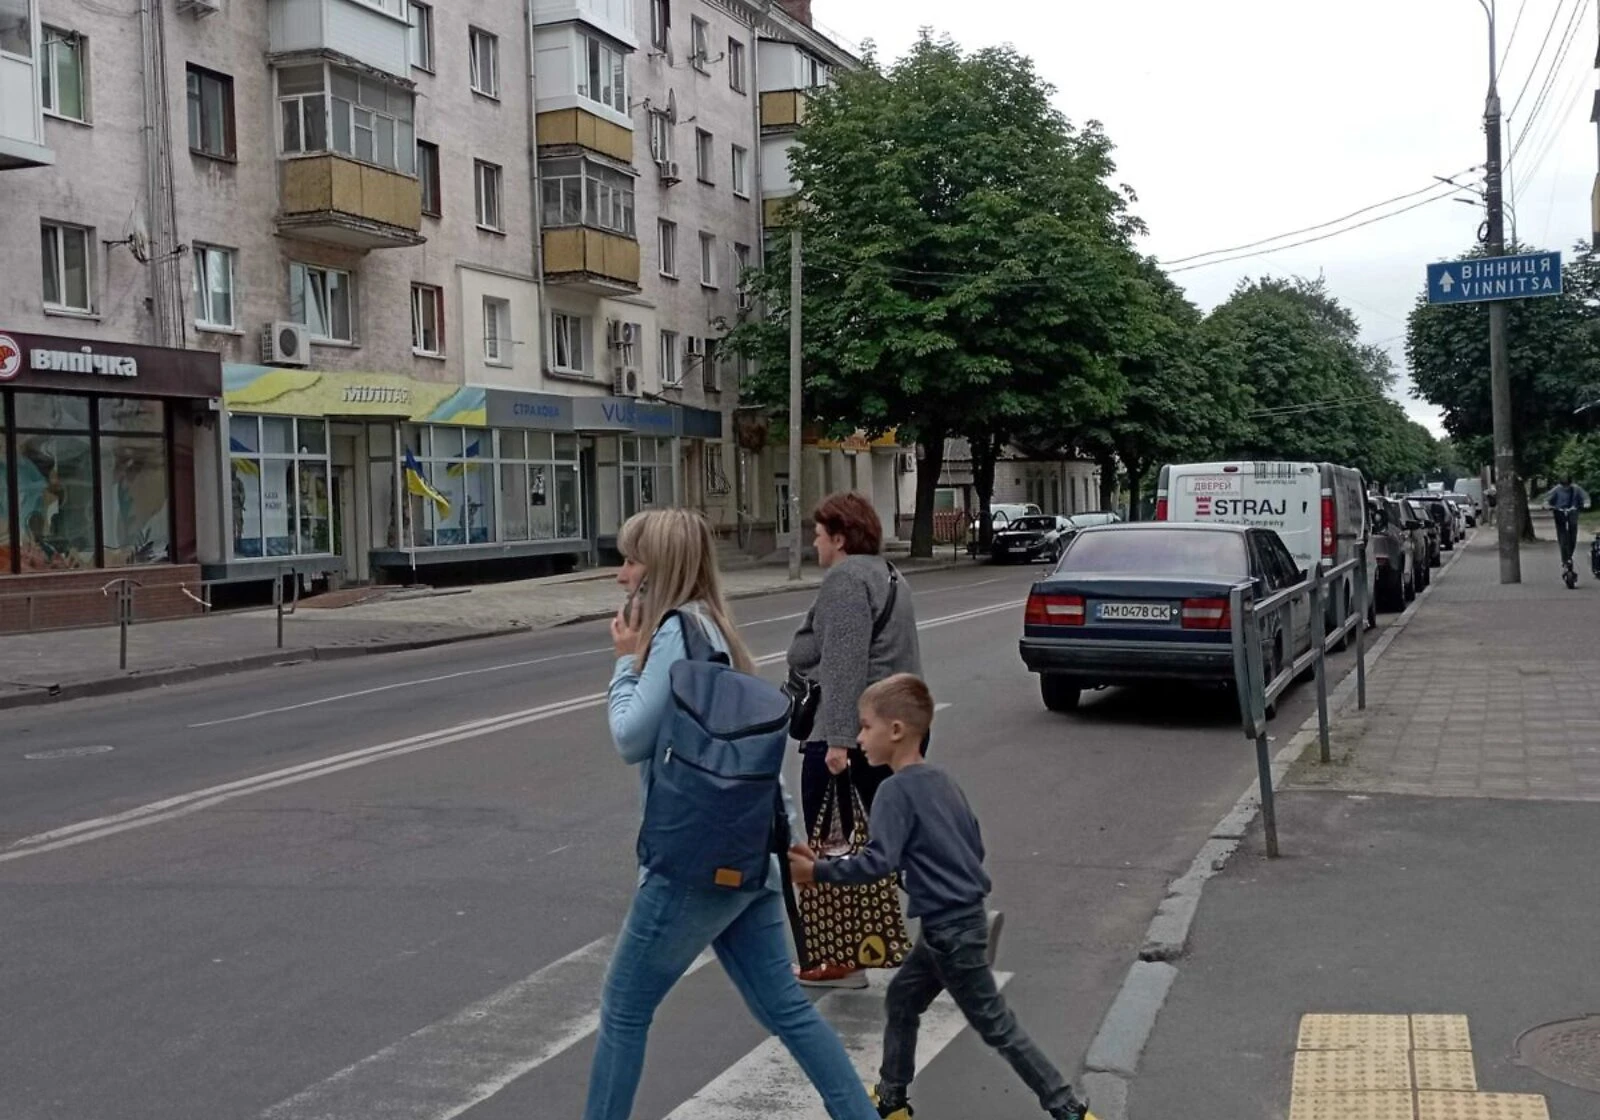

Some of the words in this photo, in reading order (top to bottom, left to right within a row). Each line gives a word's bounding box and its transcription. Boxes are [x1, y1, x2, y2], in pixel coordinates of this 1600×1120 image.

[1461, 257, 1550, 280] ВІННИЦЯ
[1461, 276, 1553, 297] VINNITSA
[1214, 499, 1287, 516] STRAJ
[1103, 605, 1120, 617] AM
[1121, 606, 1149, 618] 0478
[1151, 606, 1169, 619] CK
